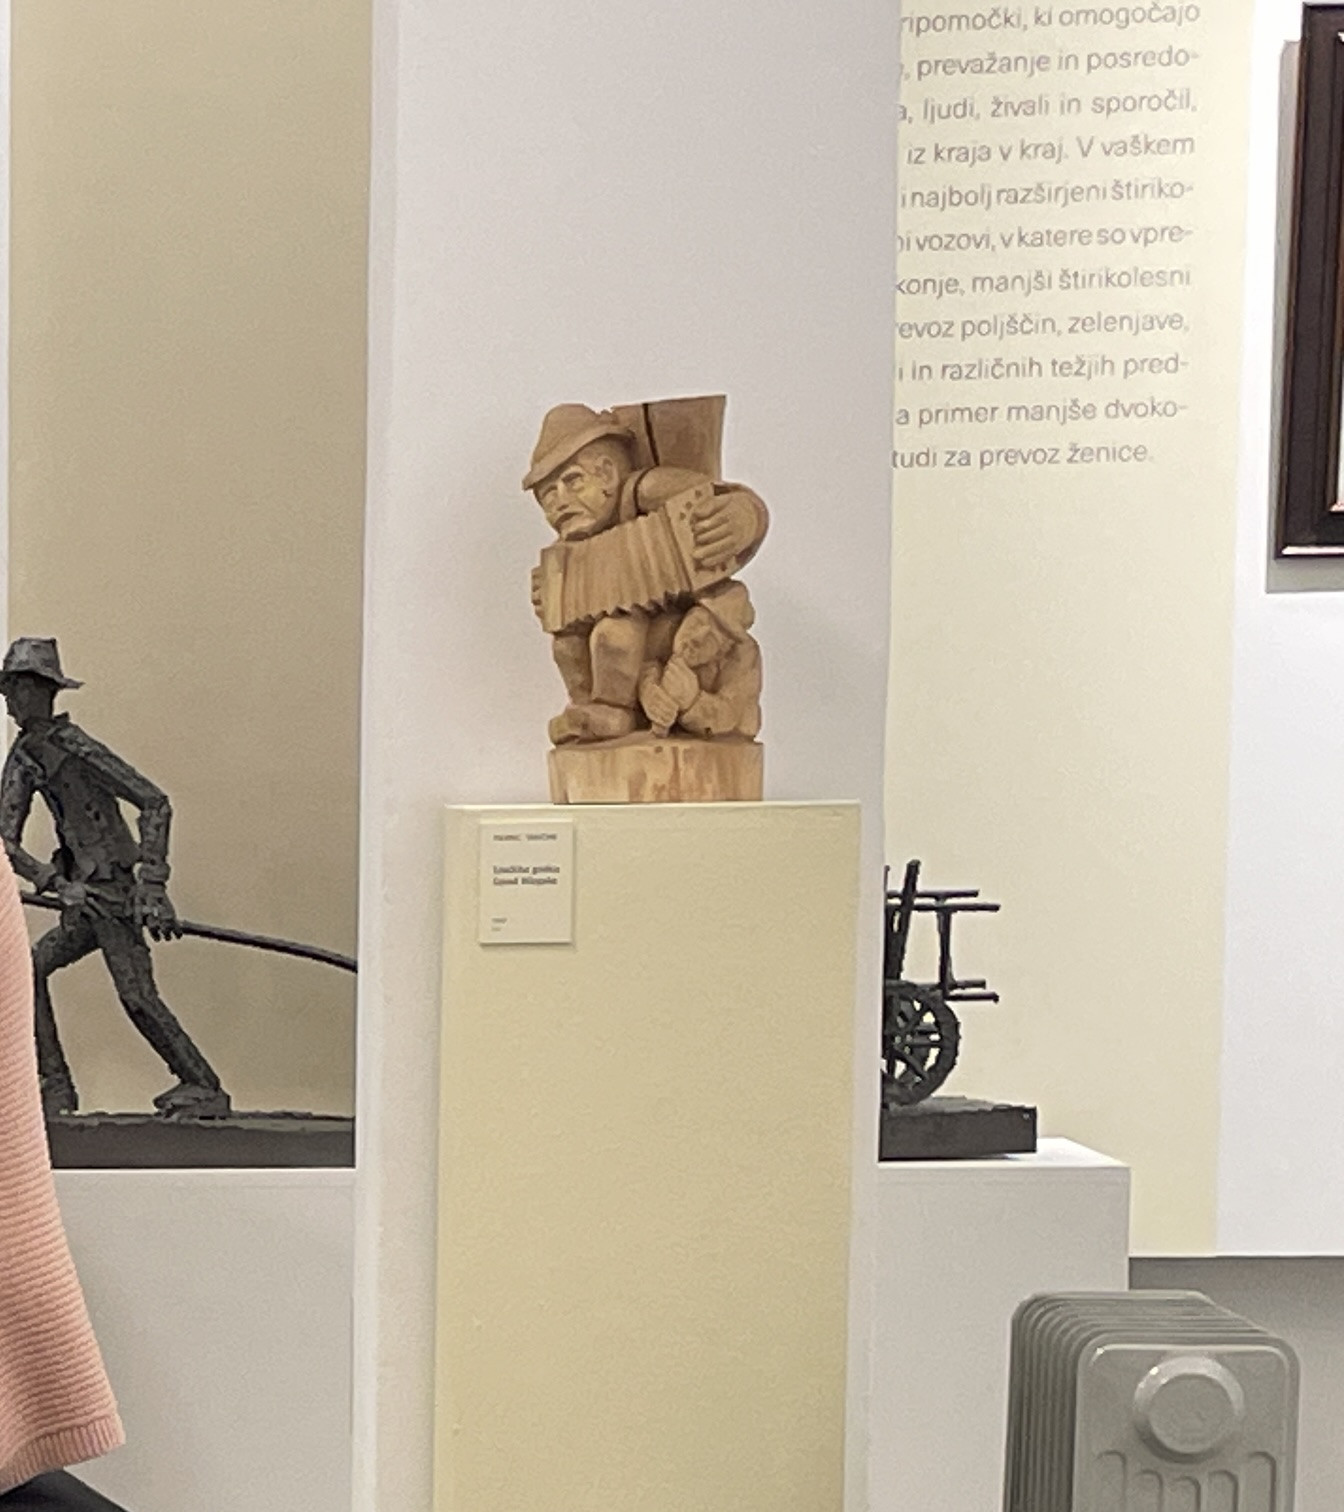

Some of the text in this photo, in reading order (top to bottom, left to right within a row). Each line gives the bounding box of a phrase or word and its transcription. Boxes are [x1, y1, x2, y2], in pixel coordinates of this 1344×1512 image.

[1033, 1, 1200, 30] ki omogočajo
[917, 50, 1051, 81] prevažanje
[1057, 50, 1079, 70] in
[1087, 46, 1198, 72] posredo-
[991, 94, 1049, 118] živali
[1060, 93, 1081, 116] in
[907, 147, 926, 166] iz
[933, 141, 992, 169] kraja
[998, 144, 1013, 162] v
[1075, 136, 1095, 158] V
[1101, 132, 1195, 157] vaškem
[910, 177, 1193, 213] najbolj razširjeni štiriko-
[999, 232, 1015, 249] v
[1017, 225, 1093, 248] katere
[1097, 228, 1126, 246] so
[1129, 225, 1192, 247] vpre-
[972, 270, 1052, 297] manjši
[1059, 265, 1190, 290] štirikolesni
[912, 353, 1188, 381] in različnih težjih pred-
[918, 396, 1187, 426] primer manjše dvoko-
[944, 449, 971, 468] za
[980, 448, 1060, 469] prevoz
